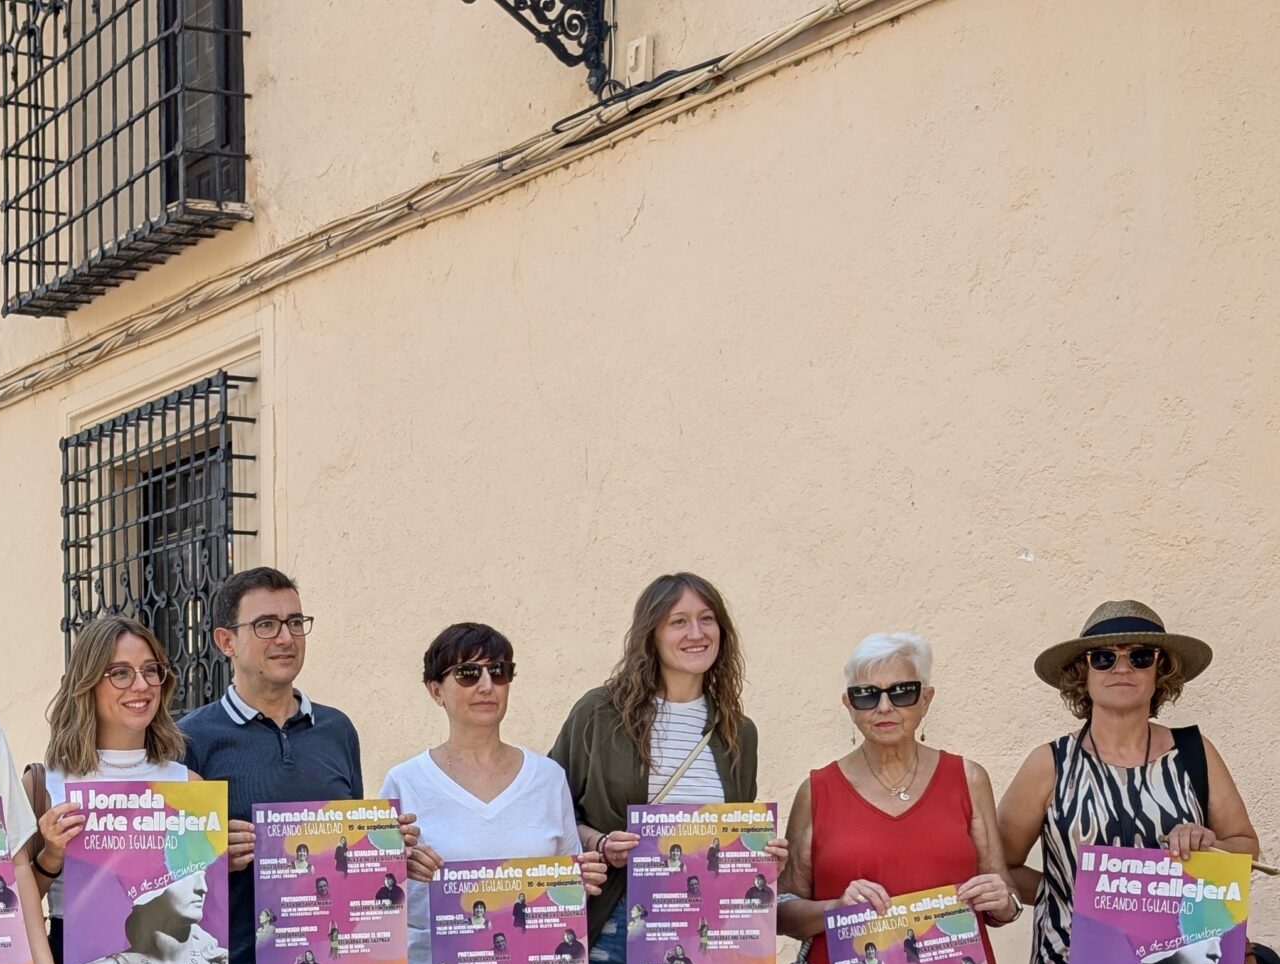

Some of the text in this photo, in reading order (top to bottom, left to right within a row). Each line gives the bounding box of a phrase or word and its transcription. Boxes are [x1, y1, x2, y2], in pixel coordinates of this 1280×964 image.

[88, 789, 164, 809] Jornada
[85, 810, 221, 835] Arte callejerA
[256, 806, 398, 823] II Jornada Arte callejerA
[631, 810, 774, 824] II Jornada Arte callejerA
[267, 823, 344, 837] CREANDO IGUALDAD
[641, 824, 717, 837] CREANDO IGUALDAD
[84, 835, 178, 850] CREANDO IGUALDAD
[443, 866, 495, 881] Jornada
[495, 865, 523, 879] Arte
[526, 862, 581, 878] callejerA
[1081, 852, 1183, 877] II Jornada
[128, 861, 207, 899] 19 de septiembre
[443, 880, 522, 894] CREANDO IGUALDAD
[1096, 874, 1241, 902] Arte callejerA
[828, 894, 960, 929] II Jornada rte callejer
[1094, 896, 1194, 915] CREANDO IGUALDAD
[838, 917, 908, 940] CREANDO IGUALDAD
[1136, 927, 1222, 957] 19 de septiembre
